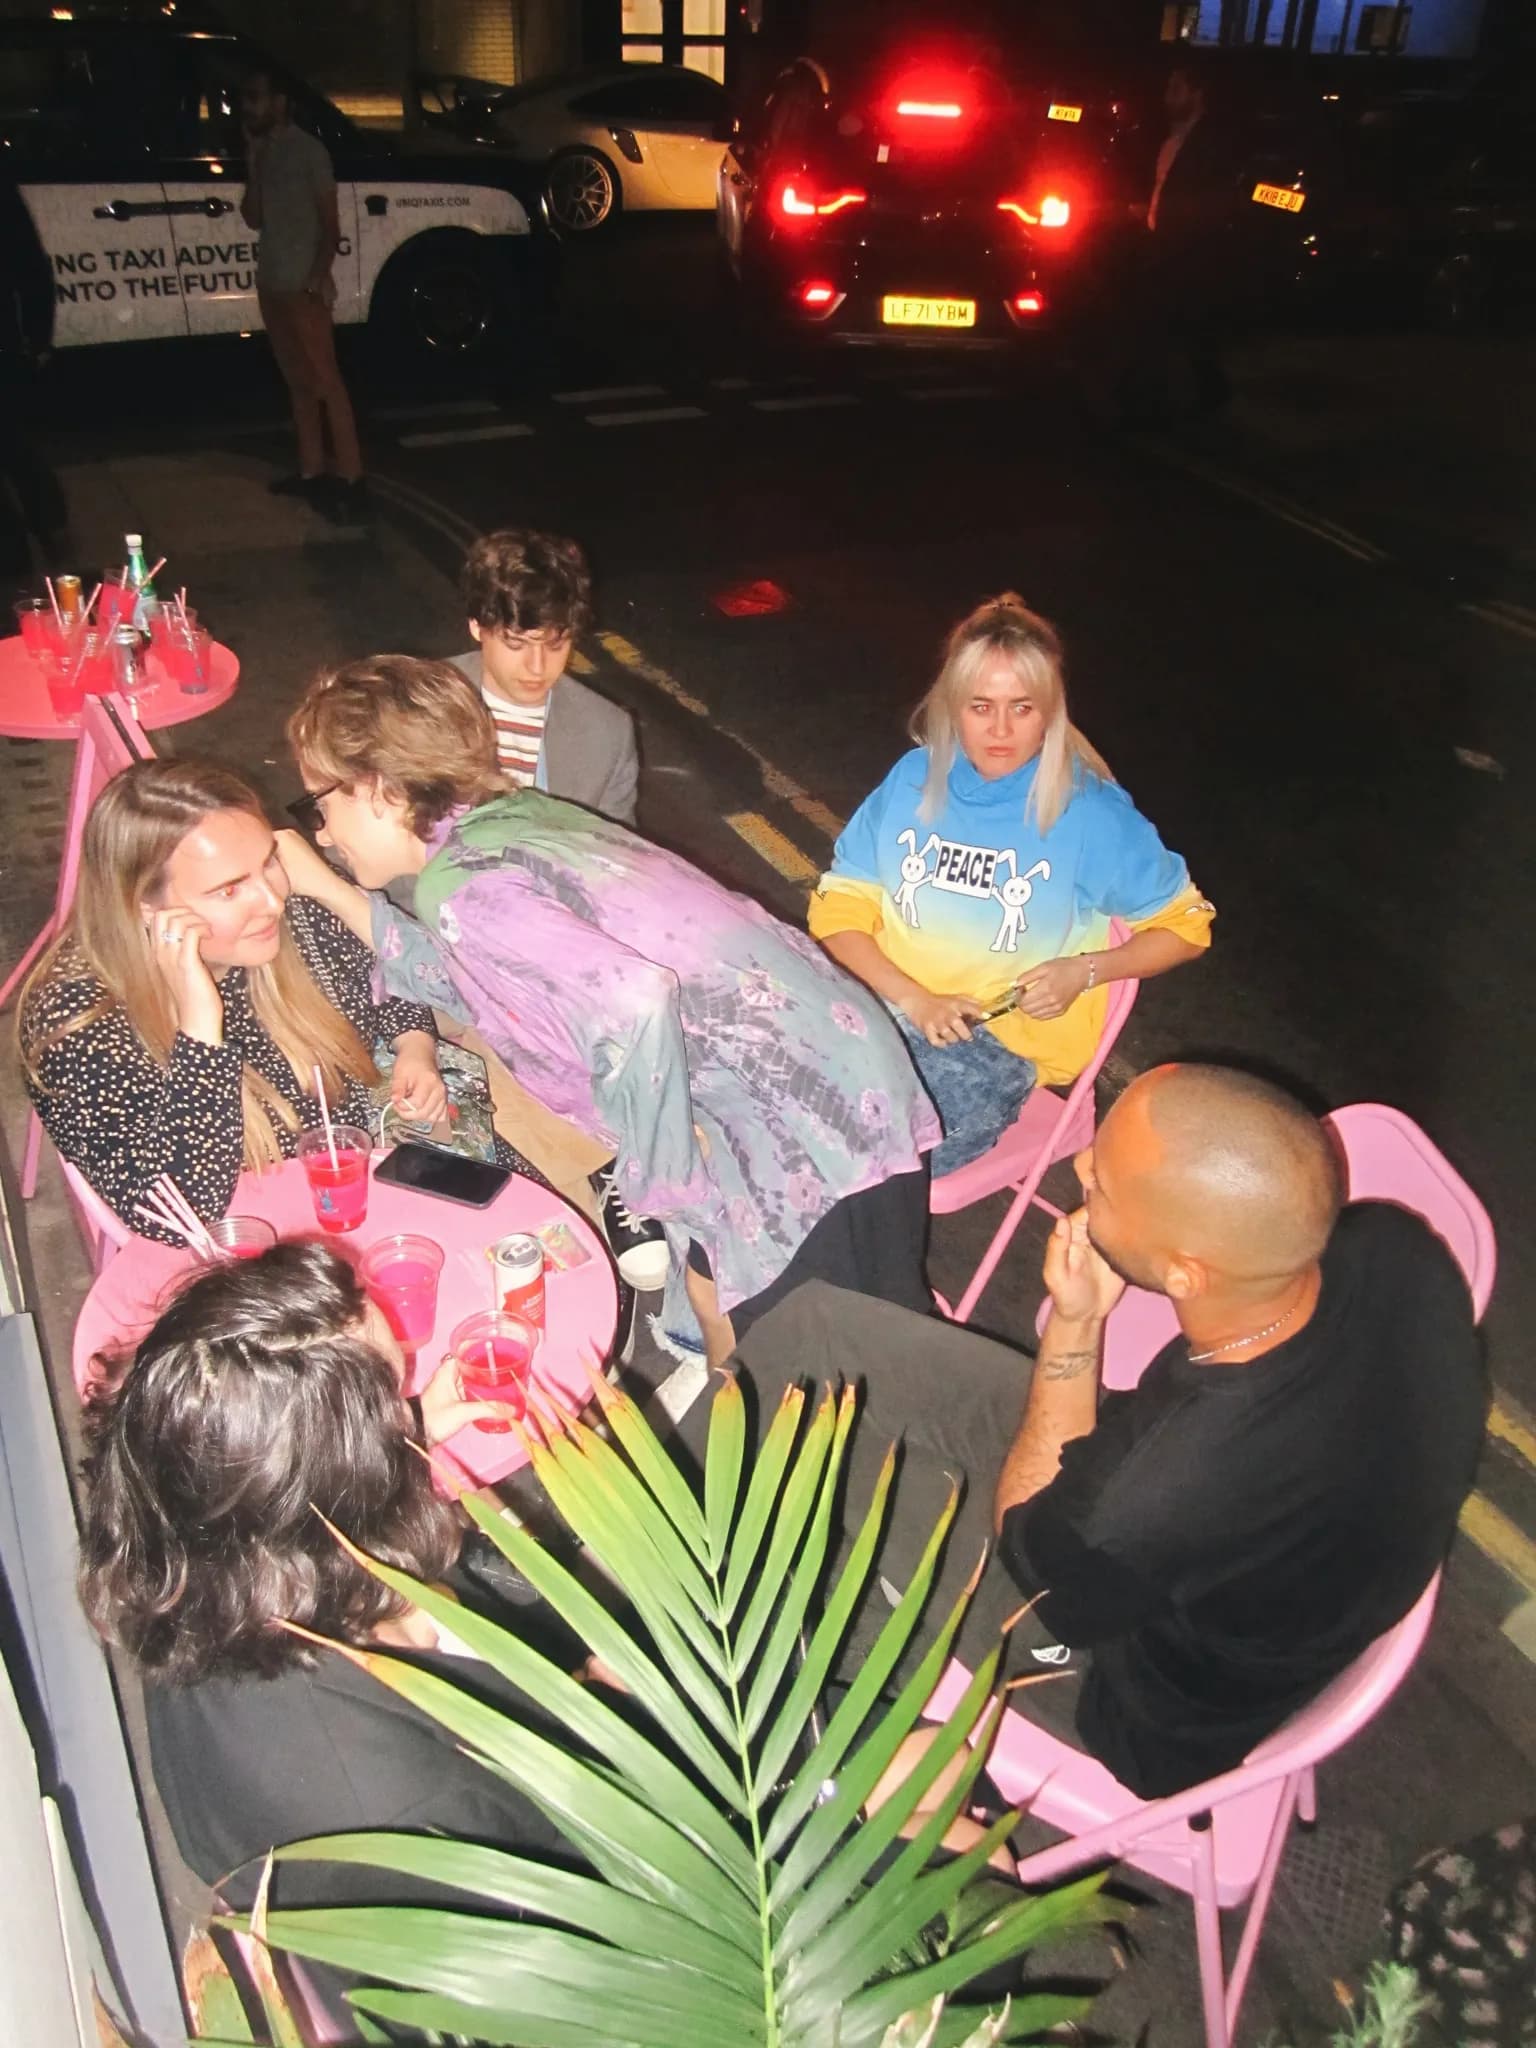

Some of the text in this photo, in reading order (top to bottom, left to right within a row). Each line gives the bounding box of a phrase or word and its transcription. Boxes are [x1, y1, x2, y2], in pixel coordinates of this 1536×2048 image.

[104, 248, 166, 271] TAXI
[55, 270, 257, 304] NTO THE FUTU
[891, 303, 968, 321] LF71 YBM
[935, 845, 996, 890] PEACE
